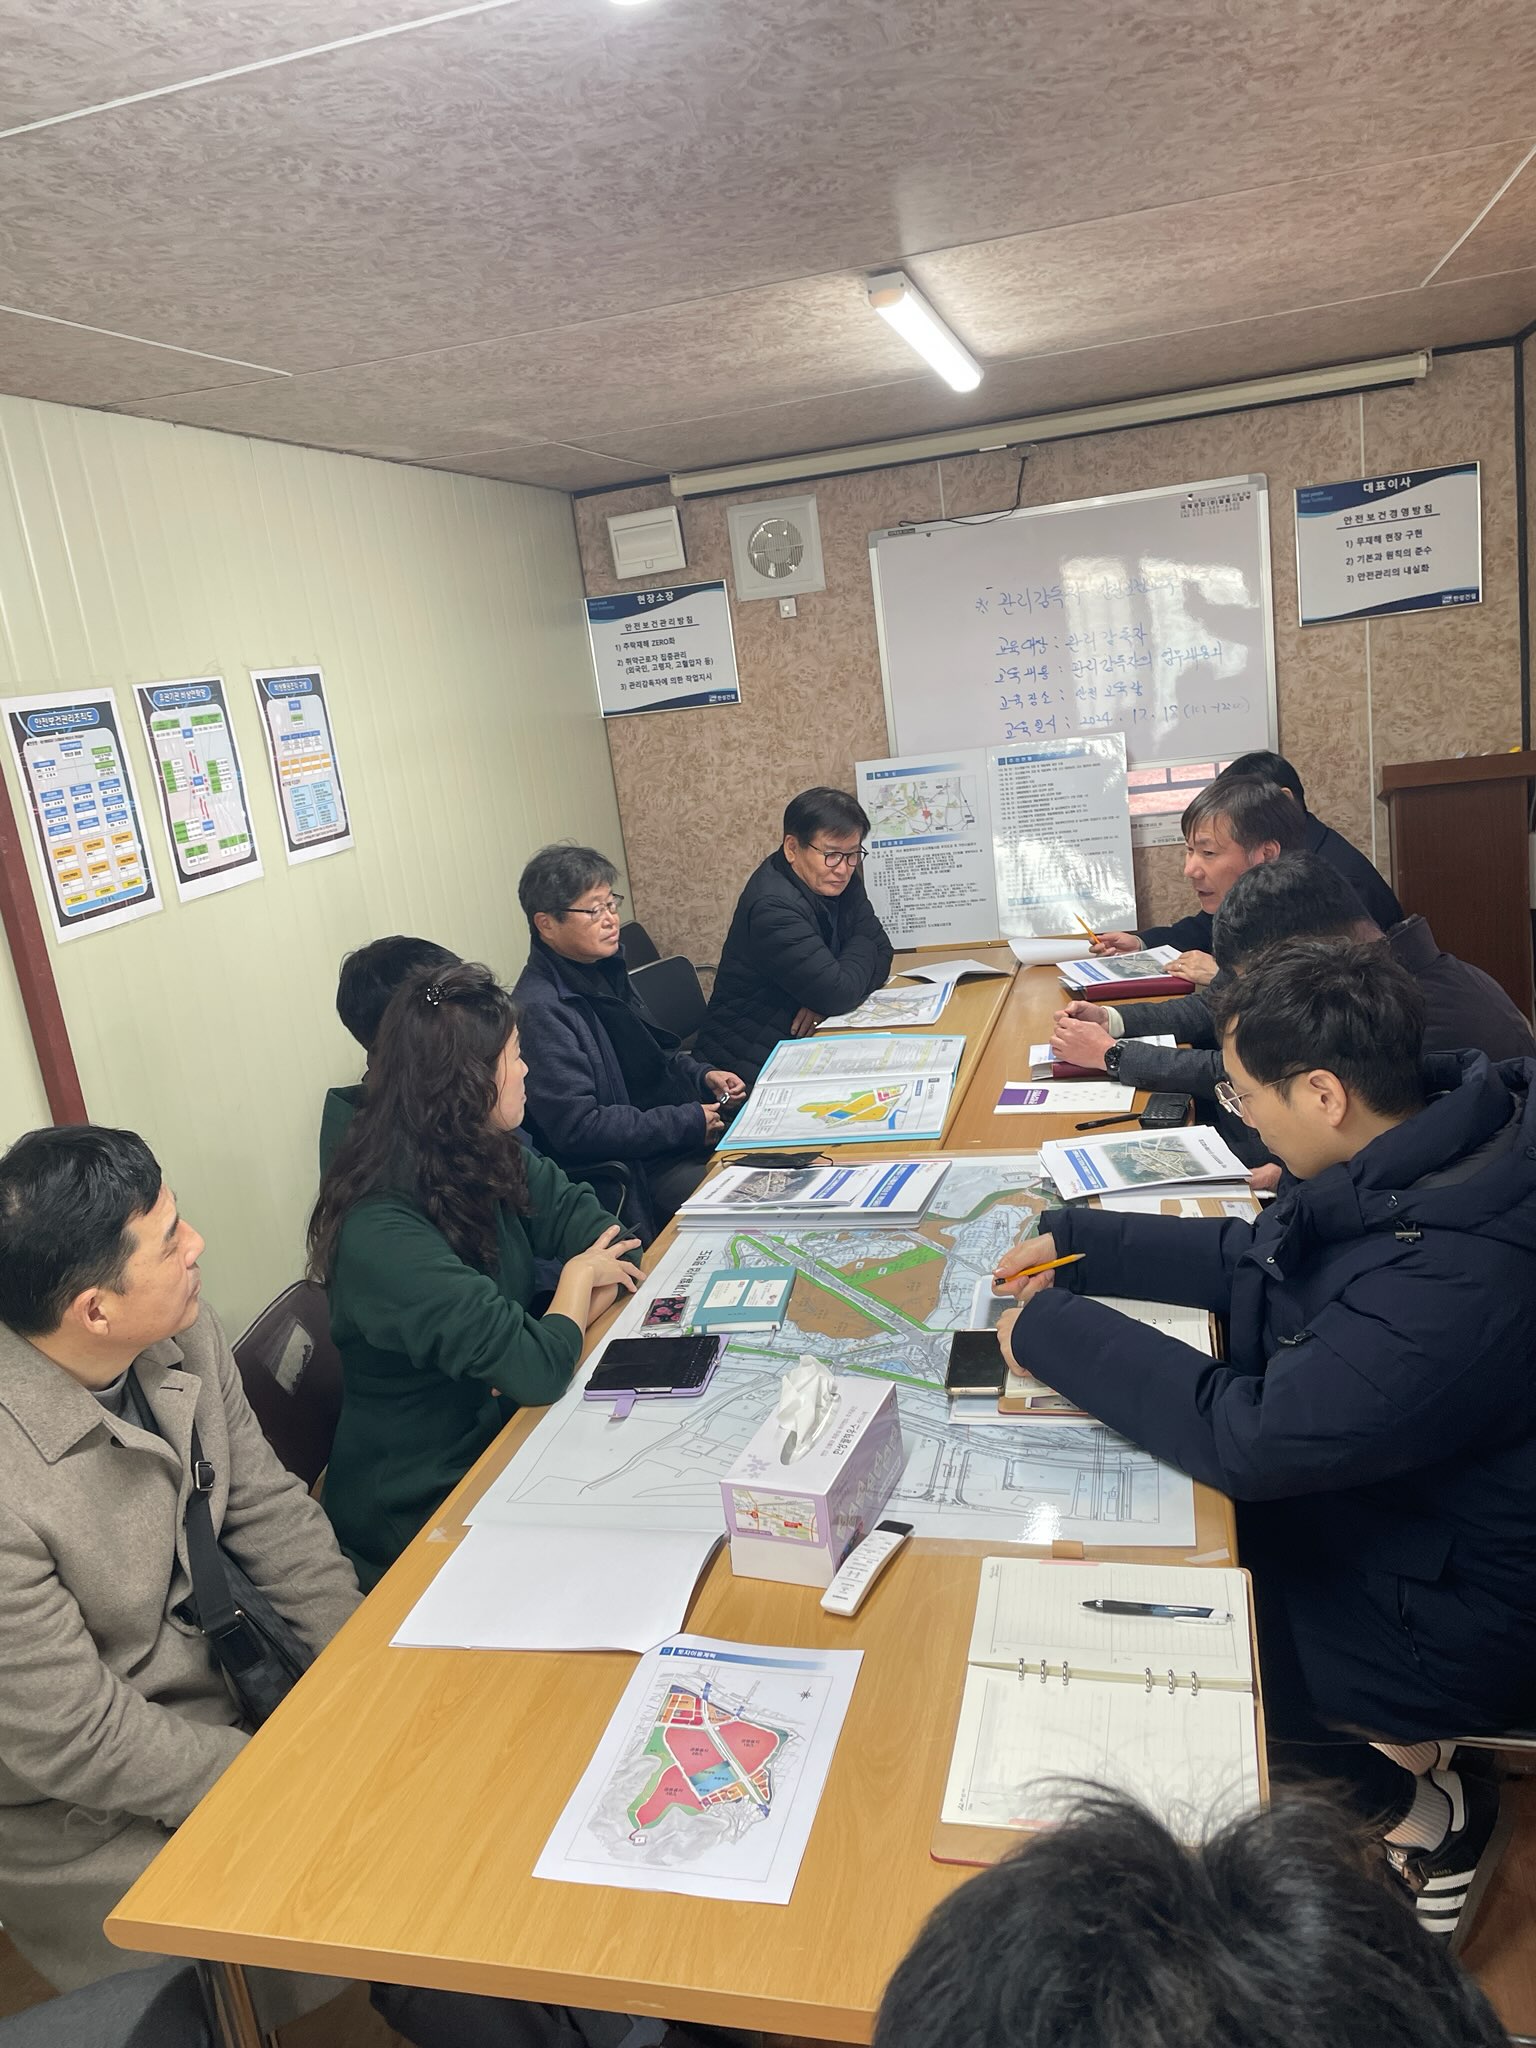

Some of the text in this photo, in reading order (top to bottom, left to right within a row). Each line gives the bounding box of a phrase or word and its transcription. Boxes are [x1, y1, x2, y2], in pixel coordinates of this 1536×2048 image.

[1362, 476, 1412, 494] 대표이사
[1343, 504, 1434, 526] 안전보건경영방침
[1346, 528, 1423, 548] 1) 무재해 현장 구현
[1346, 545, 1432, 566] 2) 기본과 원칙의 준수
[1346, 564, 1430, 583] 3) 안전관리의 내실화
[636, 591, 674, 605] 현장소장
[624, 616, 694, 632] 안전보건관리방침
[623, 640, 650, 651] 추락재해
[651, 637, 675, 647] ZERO화
[625, 654, 658, 666] 취약근로자
[660, 651, 687, 661] 집중관리
[626, 657, 714, 676] (외국인, 고령자, 고혈압자 등)
[629, 678, 668, 690] 관리감독자에
[670, 676, 684, 685] 의한
[685, 672, 712, 683] 작업지시
[34, 712, 93, 728] 안전보건관리조직도
